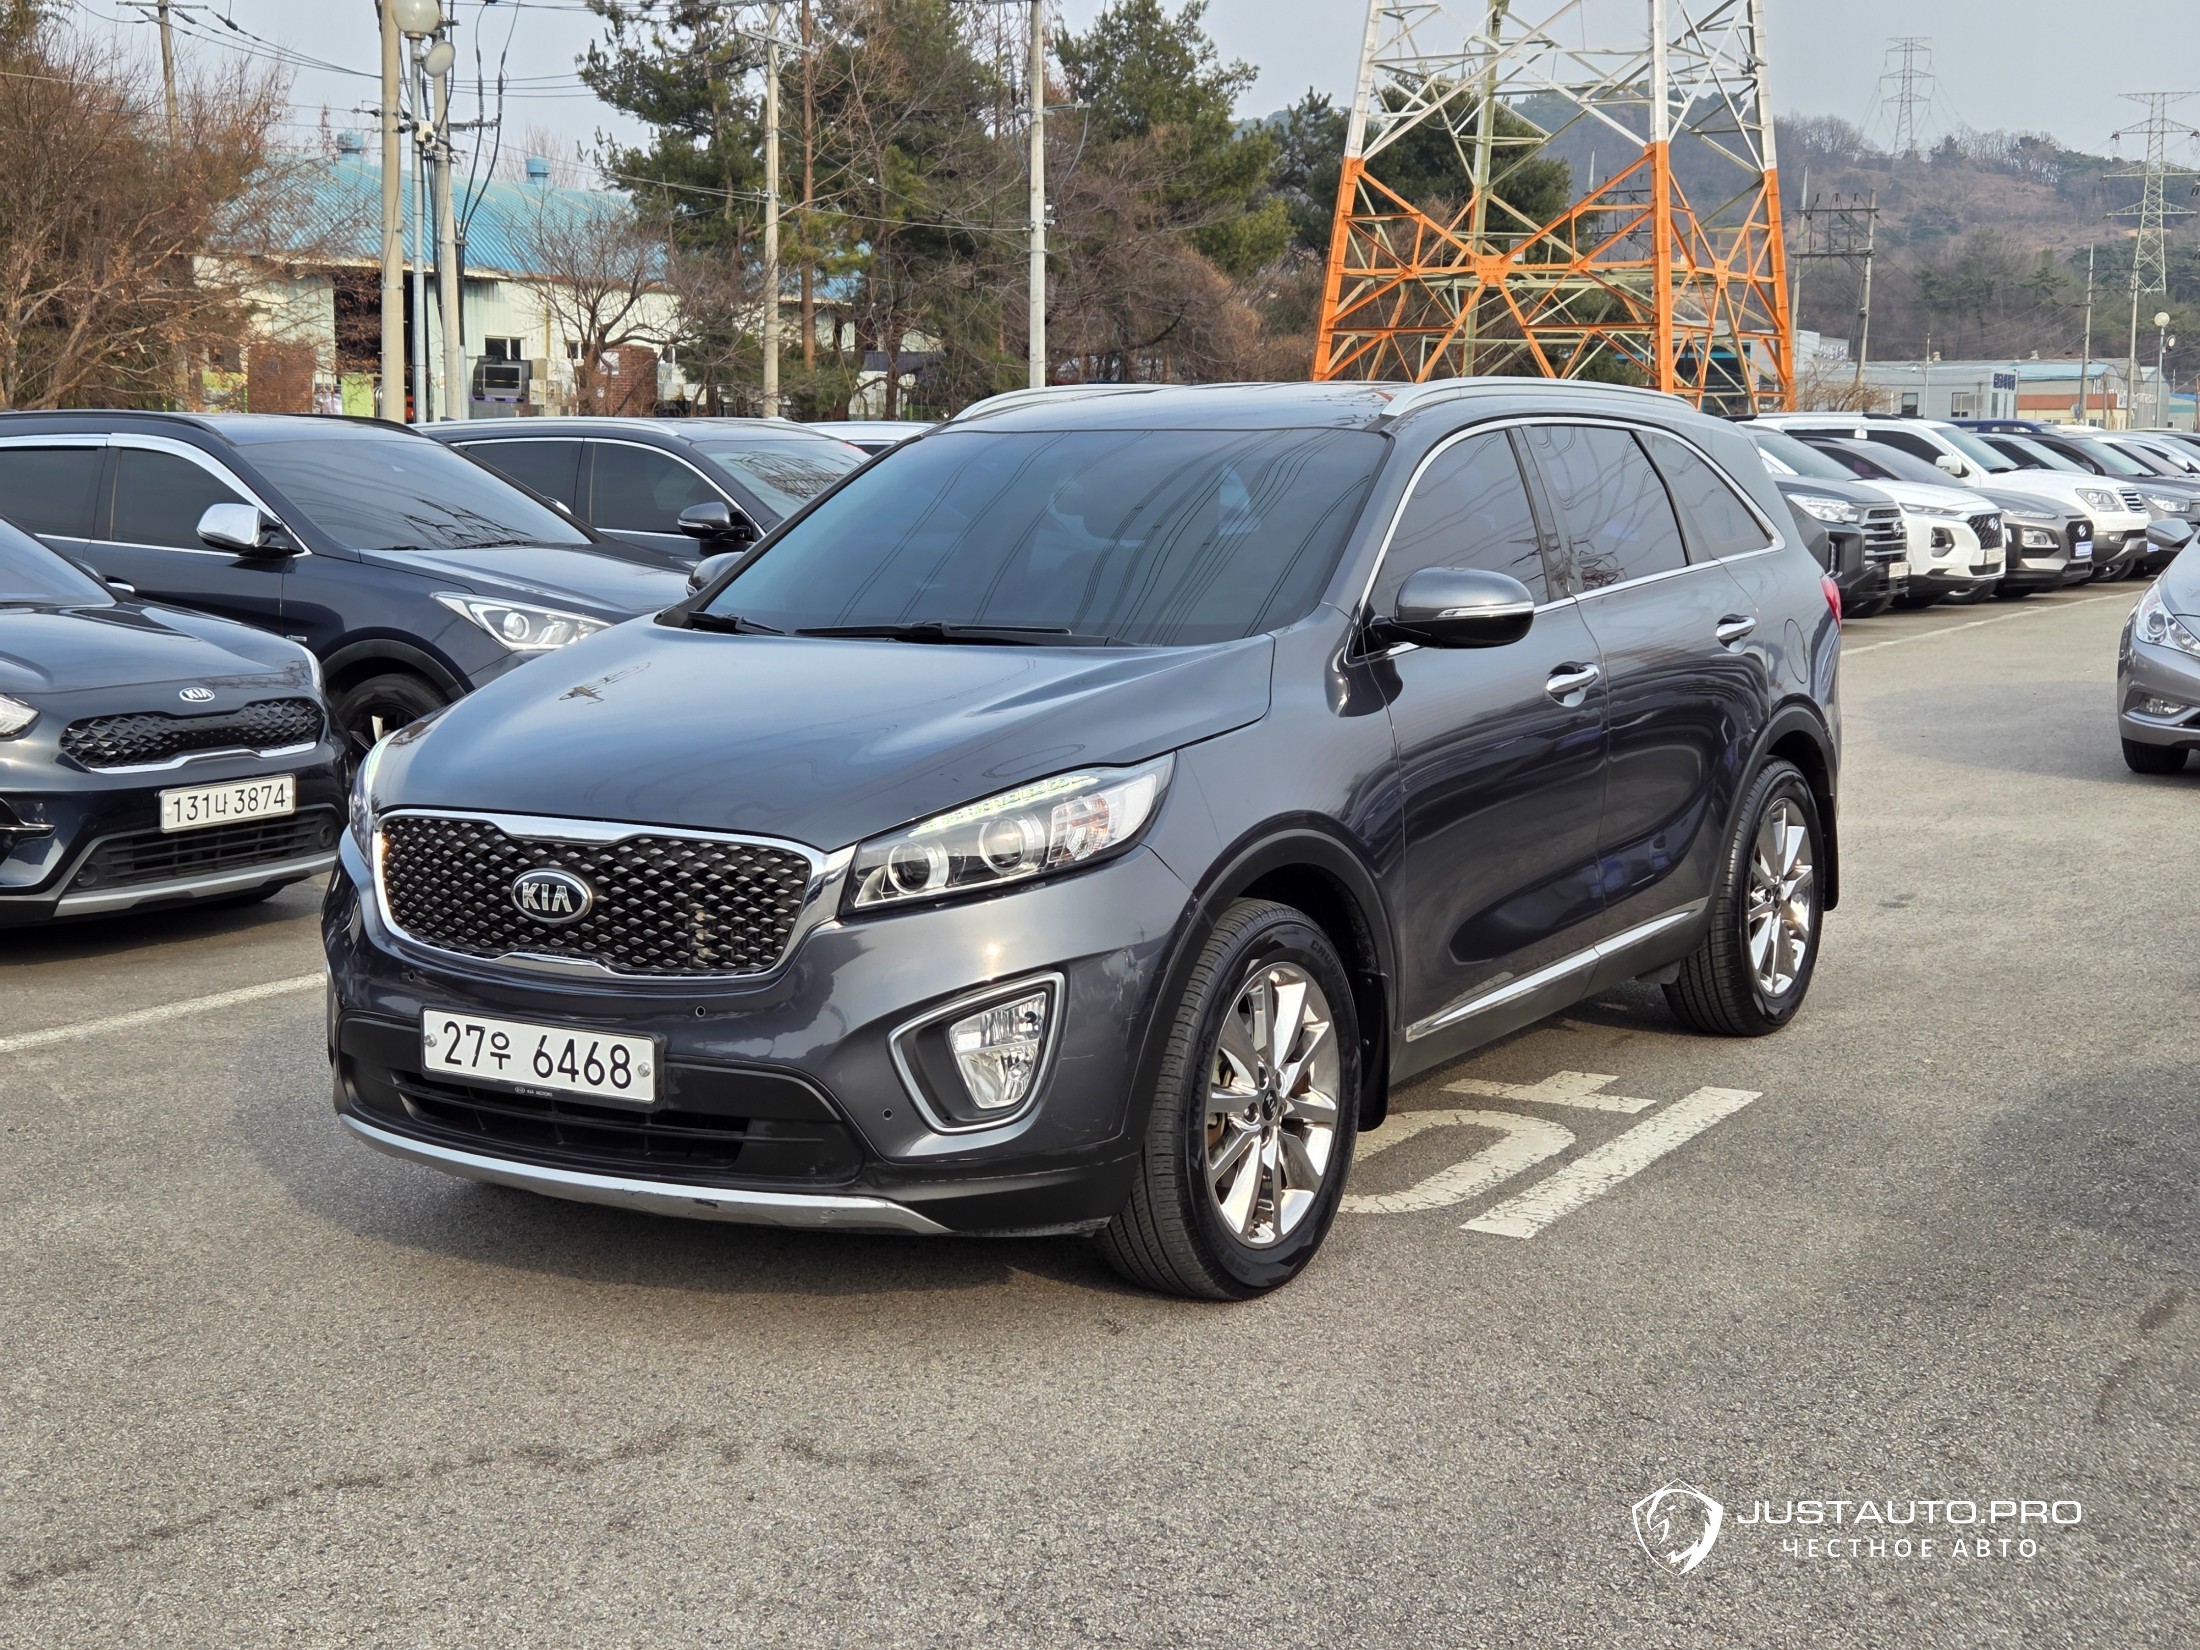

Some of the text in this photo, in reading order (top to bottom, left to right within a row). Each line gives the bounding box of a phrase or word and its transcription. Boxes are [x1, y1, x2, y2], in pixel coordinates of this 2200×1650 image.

[183, 689, 212, 699] KIA
[172, 783, 286, 823] 131나 3874
[522, 881, 573, 912] KIA
[443, 1020, 632, 1090] 27우 6468
